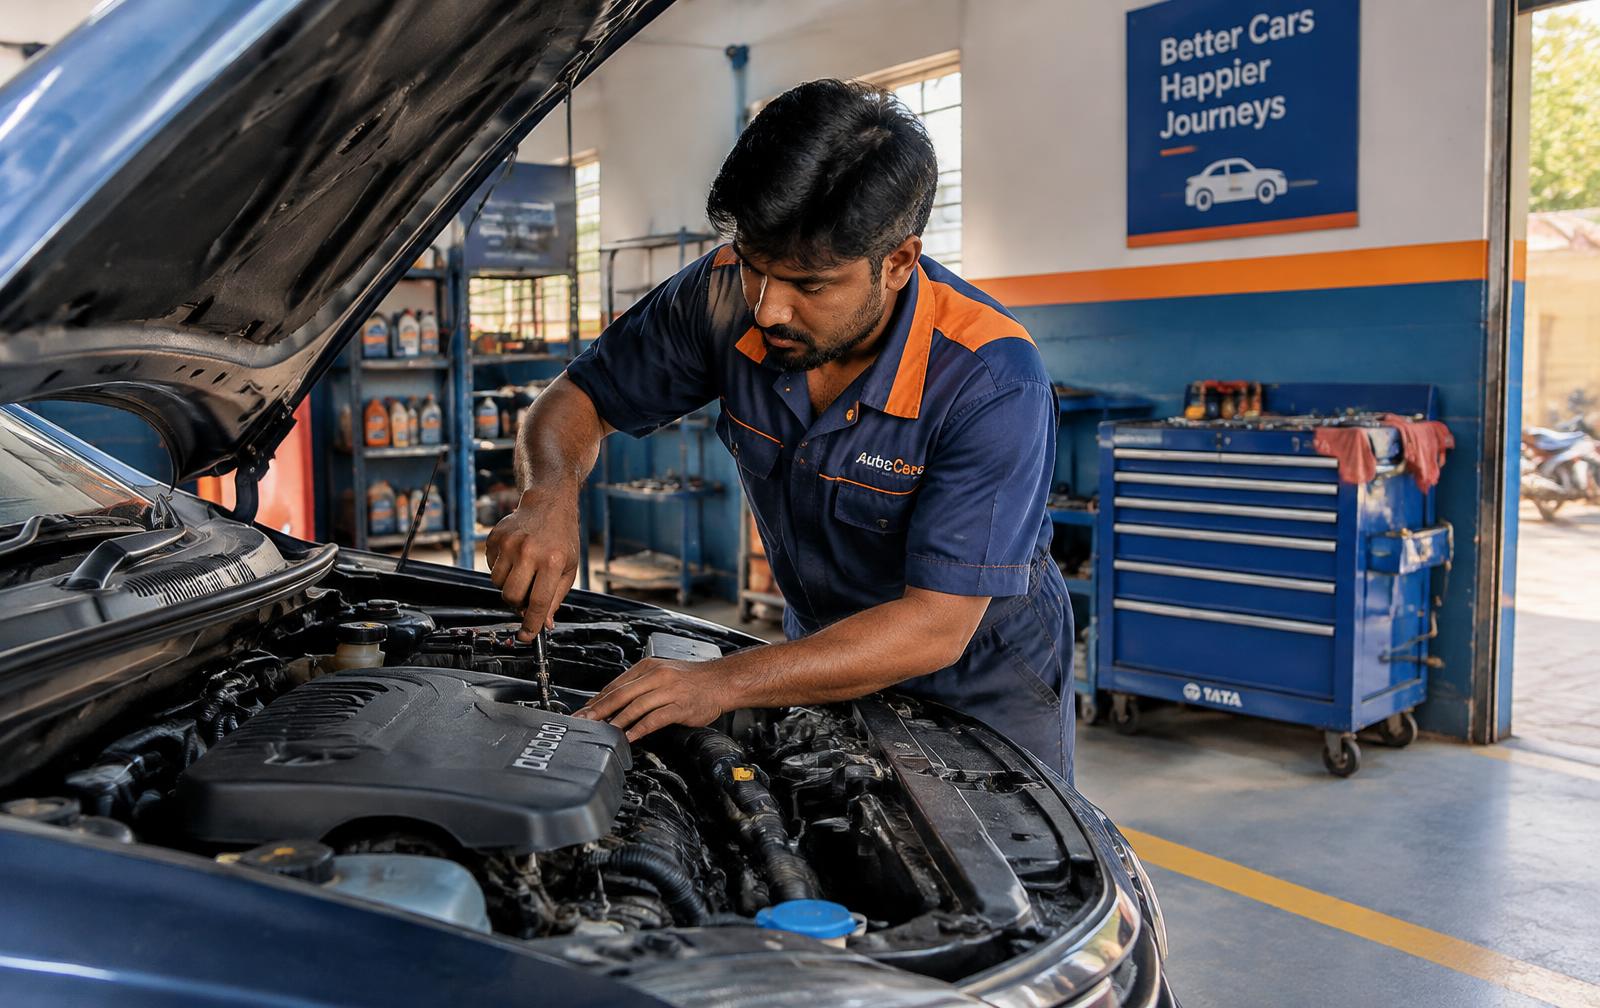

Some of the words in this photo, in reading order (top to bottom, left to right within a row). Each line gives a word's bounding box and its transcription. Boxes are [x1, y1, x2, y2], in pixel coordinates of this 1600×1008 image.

[1160, 26, 1243, 66] Better
[1249, 9, 1315, 44] Cars
[1160, 58, 1271, 103] Happier
[1160, 95, 1286, 139] Journeys
[1203, 686, 1243, 708] TATA
